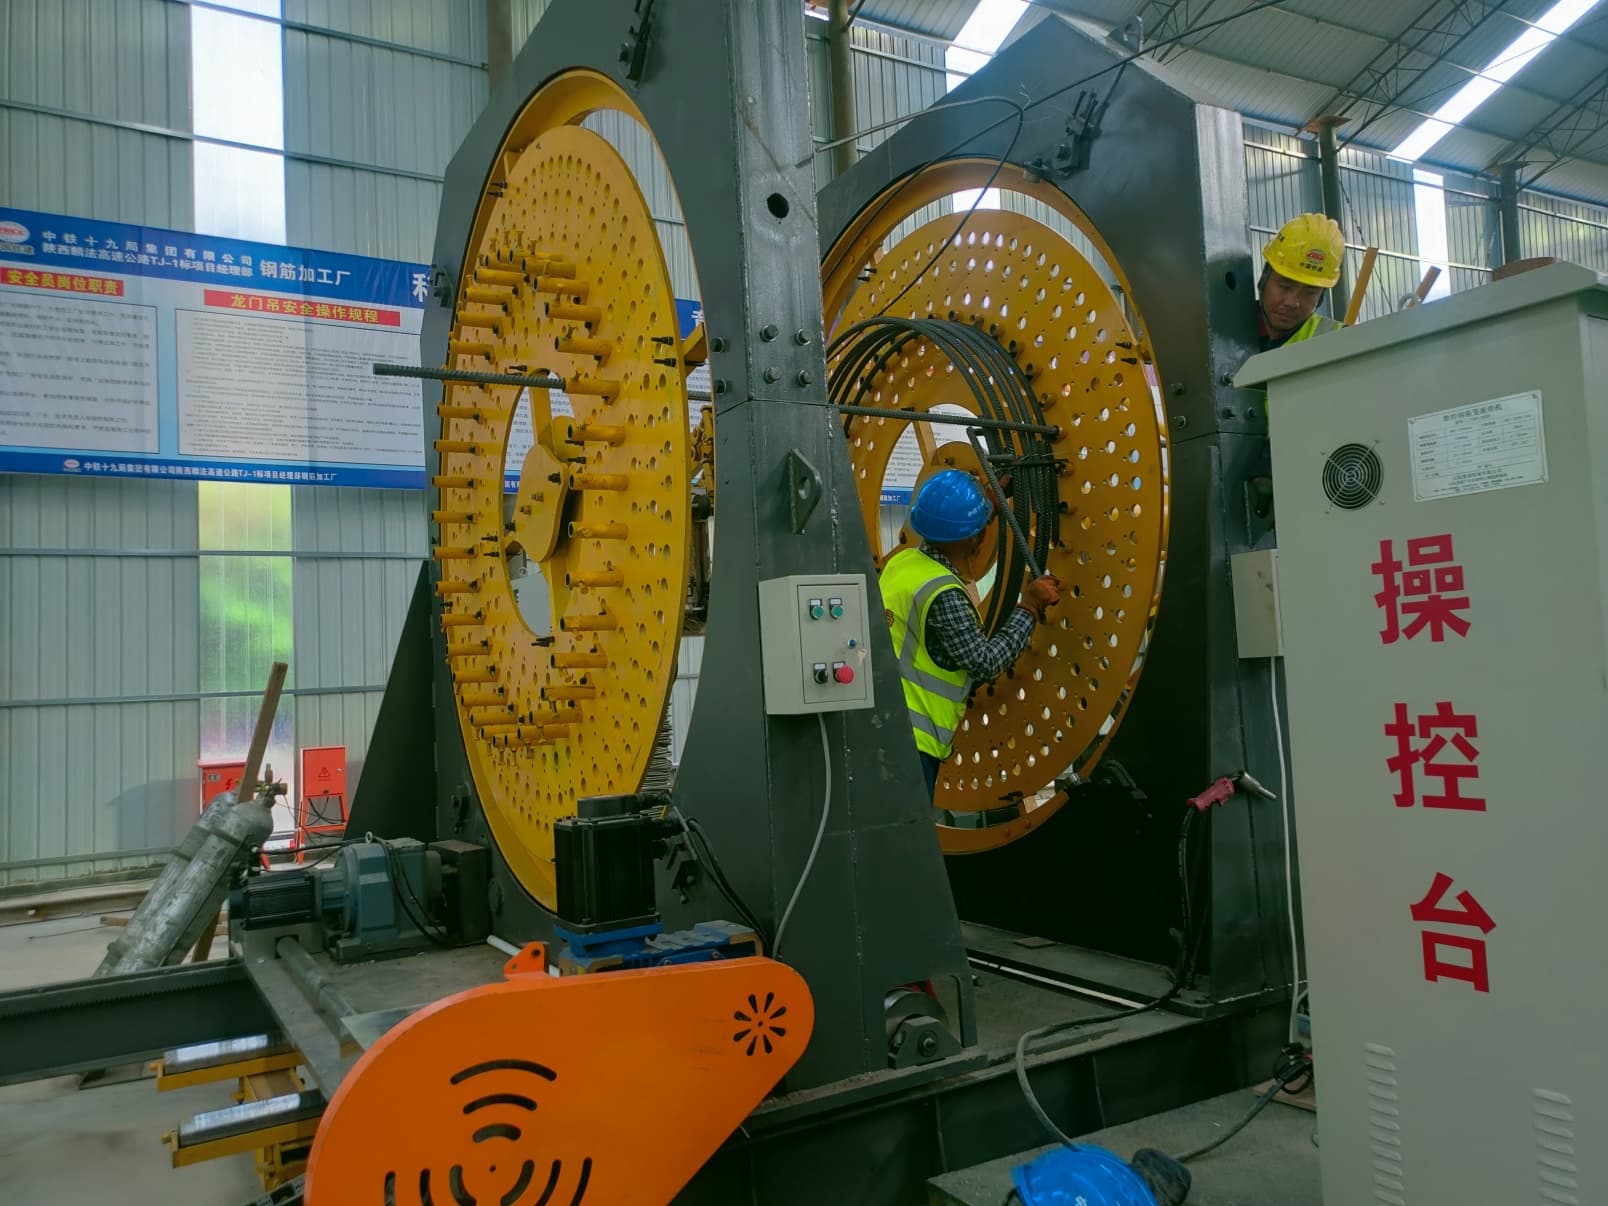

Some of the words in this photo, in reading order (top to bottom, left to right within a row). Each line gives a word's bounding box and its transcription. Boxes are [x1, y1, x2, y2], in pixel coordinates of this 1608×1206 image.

[41, 230, 253, 266] 中铁十九局集团有限公司
[7, 270, 118, 295] 安全员岗位职责
[260, 259, 351, 286] 钢筋加工厂
[231, 295, 379, 323] 龙门吊安全操作规程
[1372, 534, 1496, 992] 操控台
